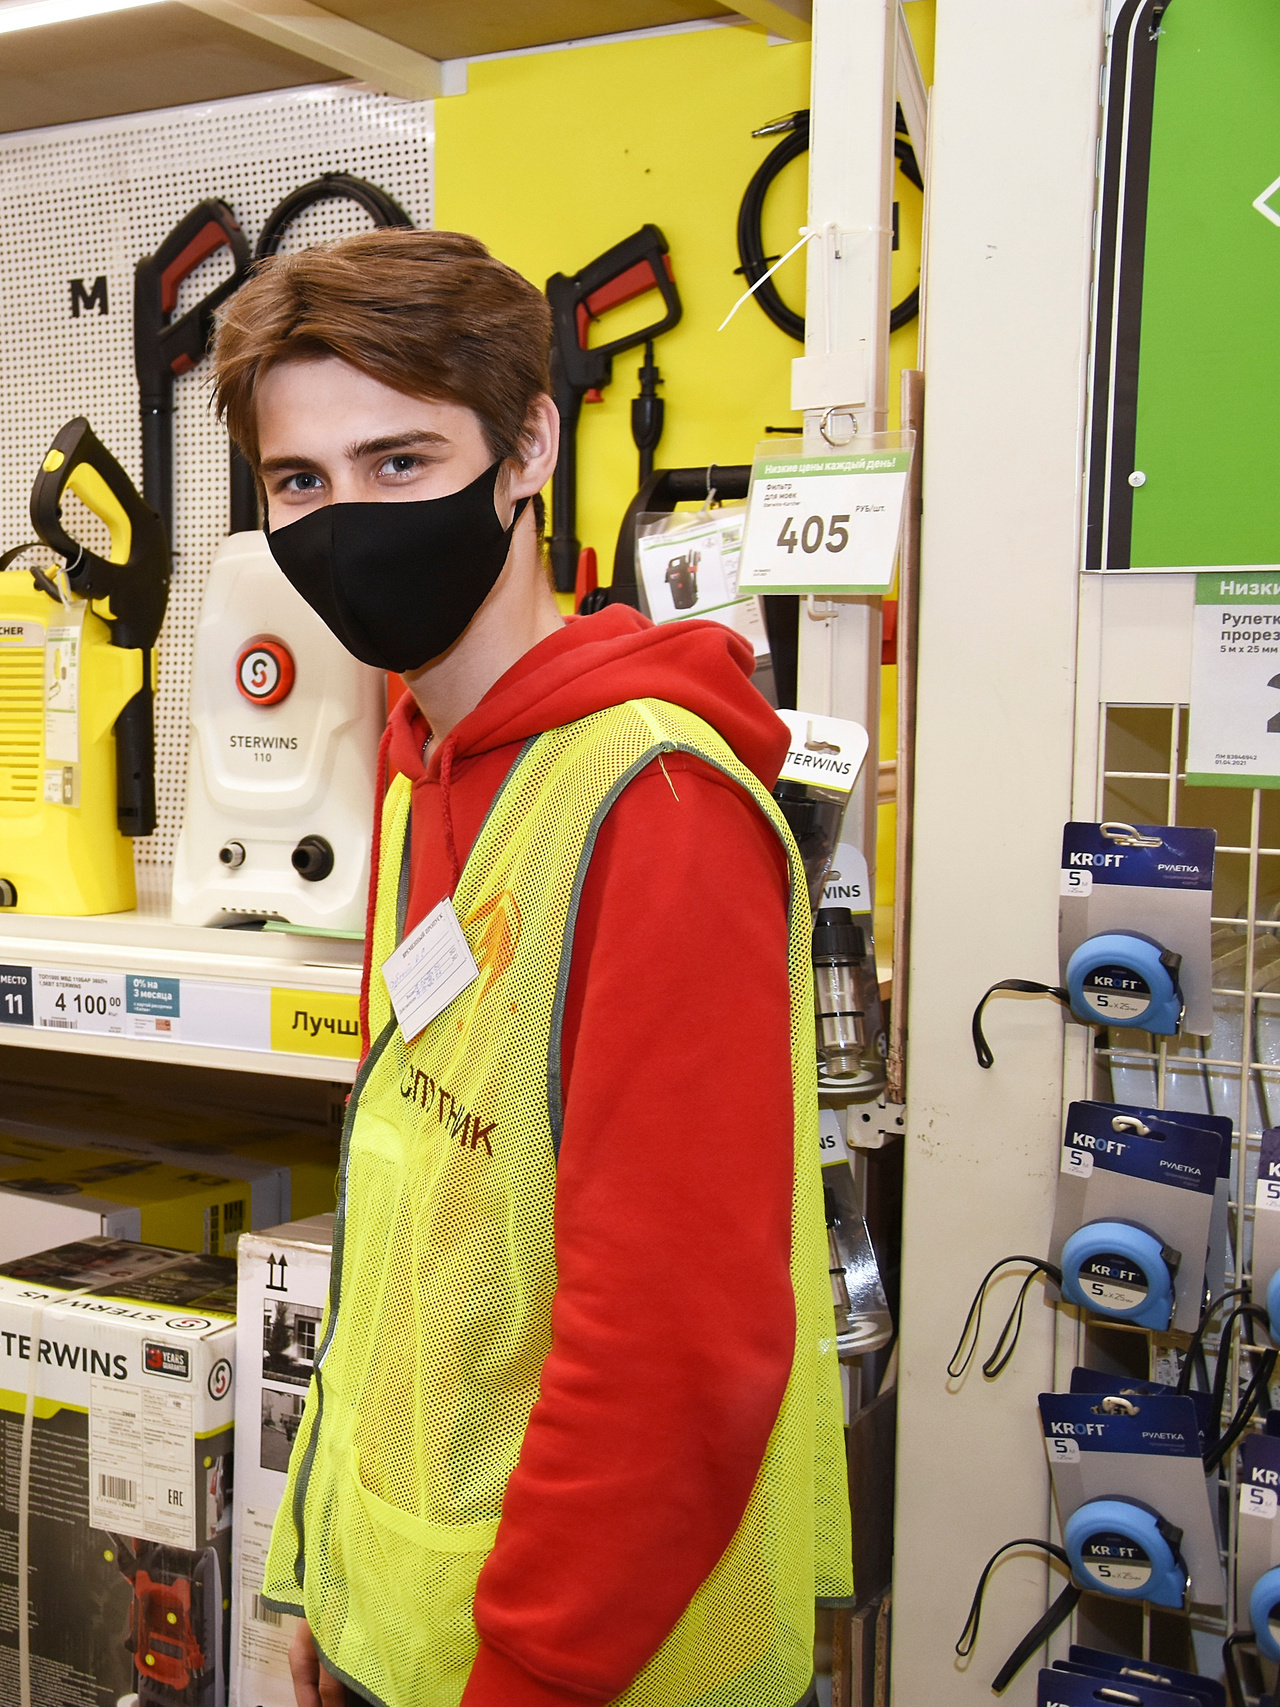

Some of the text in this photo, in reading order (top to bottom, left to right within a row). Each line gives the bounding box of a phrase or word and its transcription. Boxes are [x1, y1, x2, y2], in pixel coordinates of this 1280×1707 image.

[764, 457, 897, 474] Низкие цены каждый день!
[777, 514, 850, 554] 405
[1220, 645, 1226, 653] 5
[1247, 645, 1260, 653] 25
[230, 735, 298, 750] STERWINS
[254, 752, 272, 763] 110
[1070, 852, 1124, 868] KROFT
[1157, 863, 1200, 873] РУЛЕТКА
[0, 974, 27, 986] МЕСТО
[133, 978, 158, 989] 0% на
[1094, 976, 1138, 990] KROFT
[133, 989, 173, 1002] 3 месяца
[1097, 994, 1109, 1007] 5
[5, 993, 23, 1015] 11
[55, 992, 121, 1015] 4 100 00
[1072, 1131, 1126, 1156] KROFT
[1160, 1160, 1201, 1175] РУЛЕТКА
[1091, 1264, 1136, 1281] KROFT
[1092, 1283, 1104, 1295] 5
[147, 1348, 184, 1368] 3 YEARS
[1051, 1422, 1105, 1436] KROFT
[1142, 1431, 1184, 1440] РУЛЕТКА
[168, 1489, 184, 1507] EAC
[1091, 1545, 1134, 1557] KROFT
[1098, 1565, 1111, 1577] 5
